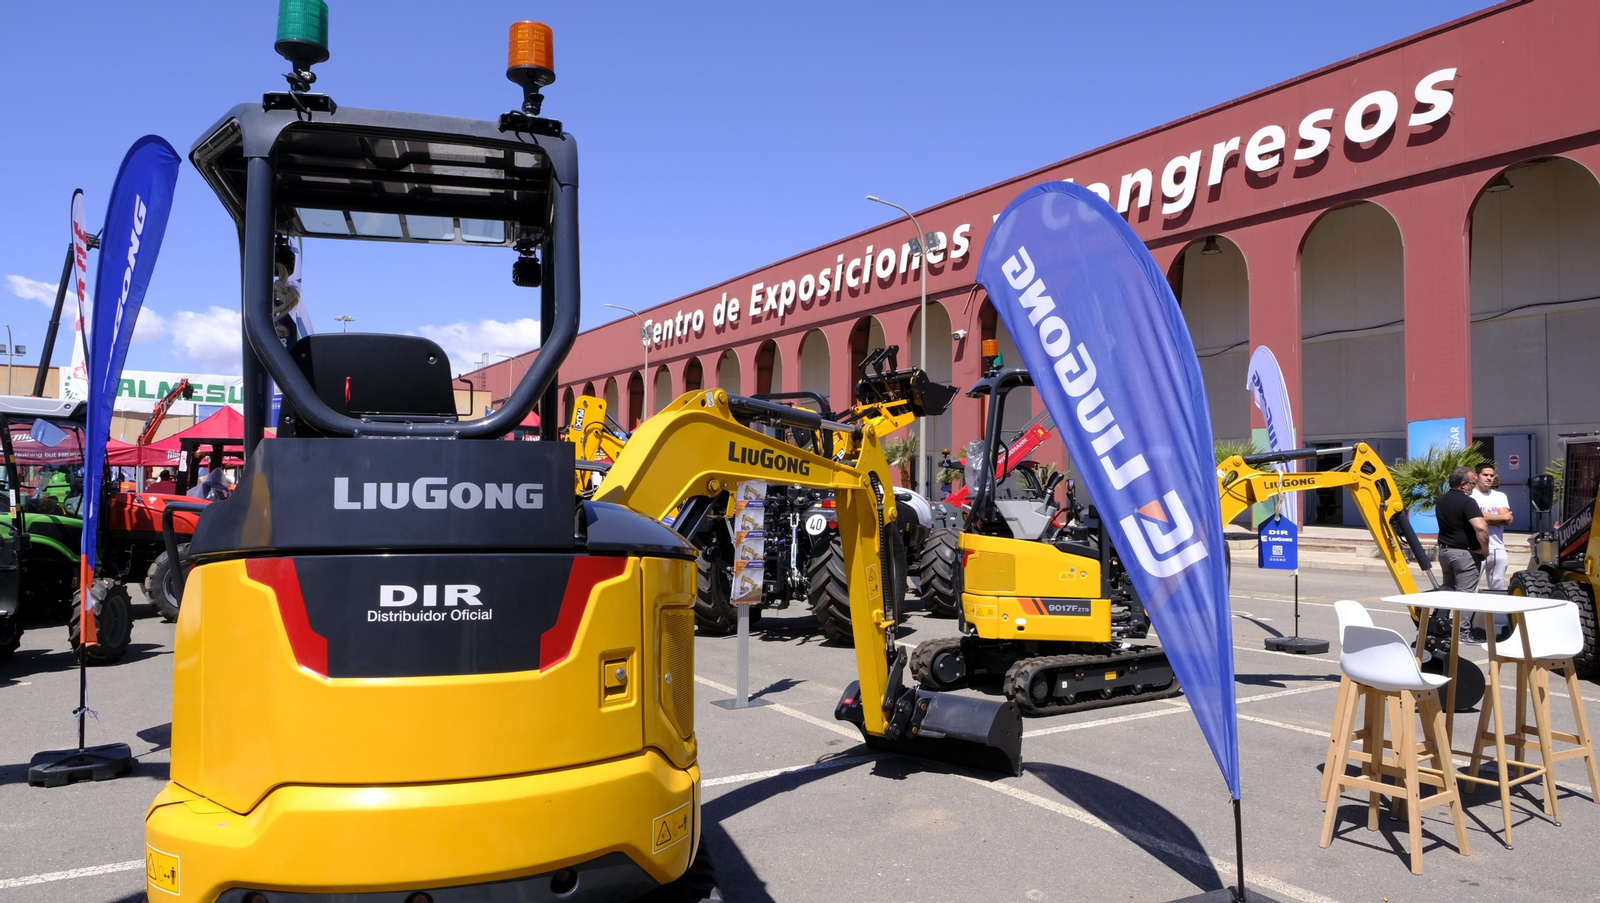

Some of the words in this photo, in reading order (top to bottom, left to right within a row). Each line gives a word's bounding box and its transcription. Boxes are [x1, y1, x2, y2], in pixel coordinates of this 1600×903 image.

[642, 308, 704, 346] Centro
[712, 292, 740, 327] de
[749, 223, 971, 317] Exposiciones
[810, 518, 823, 531] 40
[380, 584, 483, 606] DIR
[367, 611, 447, 622] Distribuidor
[450, 609, 492, 620] Oficial
